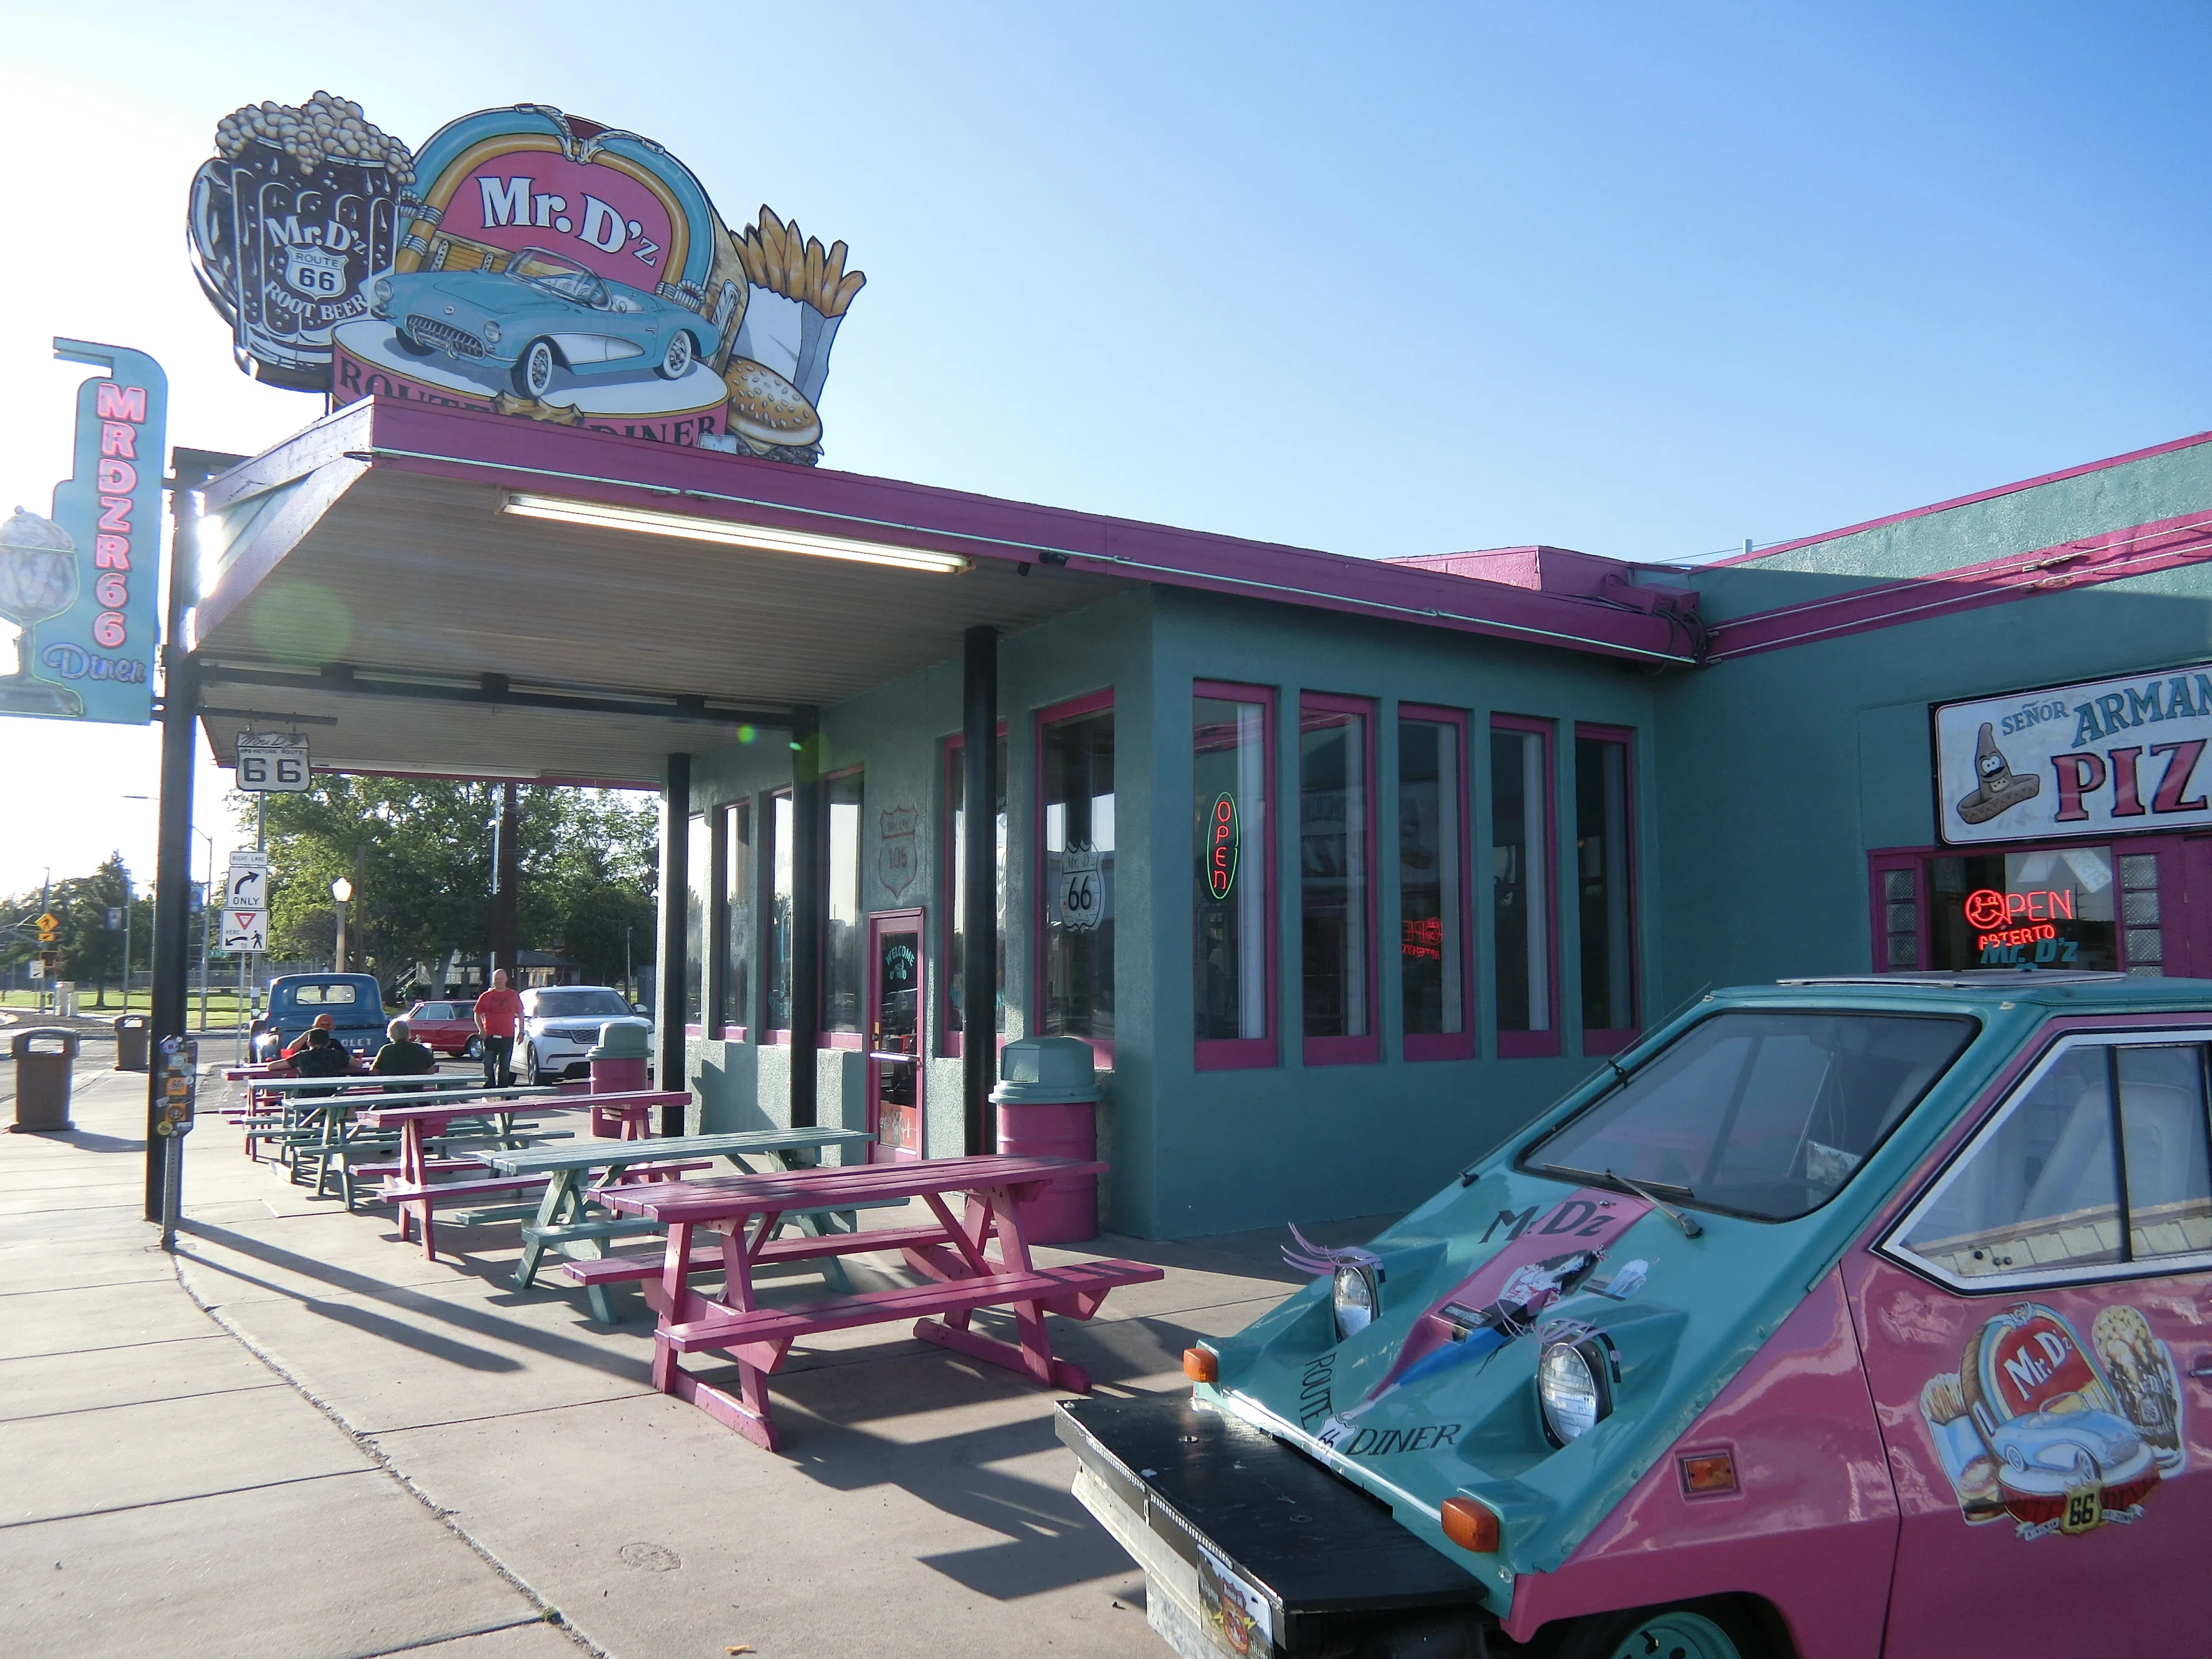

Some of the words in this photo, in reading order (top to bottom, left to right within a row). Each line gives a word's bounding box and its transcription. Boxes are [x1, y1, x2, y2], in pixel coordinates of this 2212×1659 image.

[477, 176, 572, 233] Mr.
[577, 192, 660, 267] D'z
[296, 253, 339, 267] ROUTE
[299, 267, 335, 291] 66
[264, 280, 316, 318] ROOT
[320, 294, 367, 320] BEER
[41, 642, 147, 684] Diner
[2002, 700, 2070, 736] SEÑOR
[2051, 738, 2208, 823] PIZ
[1065, 856, 1079, 870] Mr.
[1213, 801, 1232, 890] OPEN
[233, 896, 260, 905] ONLY
[1068, 875, 1092, 911] 66
[1965, 890, 2073, 929] OPEN
[885, 945, 914, 967] WELCOME
[2035, 937, 2079, 963] D'z
[1299, 1351, 1337, 1430] ROUTE
[2005, 1345, 2053, 1402] Mr.
[1318, 1427, 1341, 1450] 66
[1345, 1423, 1463, 1456] DINER
[2069, 1493, 2095, 1527] 66
